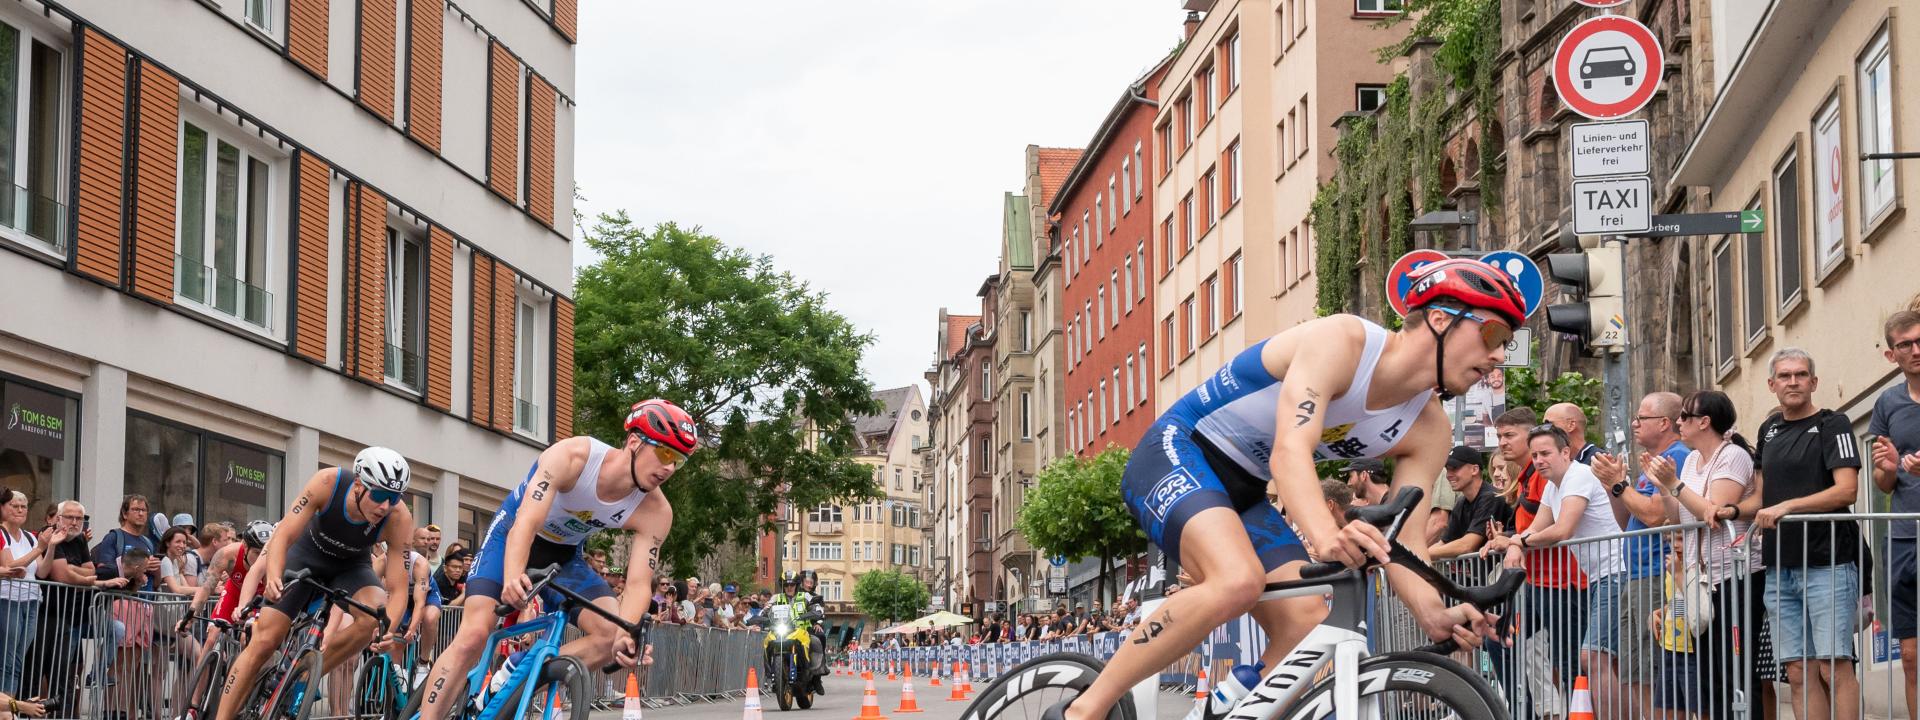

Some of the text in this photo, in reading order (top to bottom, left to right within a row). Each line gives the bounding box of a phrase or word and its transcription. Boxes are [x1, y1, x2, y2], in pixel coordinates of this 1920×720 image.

[1582, 131, 1637, 143] Linien- und
[1577, 143, 1644, 155] Lieferverkehr
[1602, 156, 1619, 166] frei
[1583, 188, 1639, 211] TAXI
[1600, 214, 1624, 227] frei
[1417, 278, 1431, 293] 47
[1605, 331, 1619, 340] 22
[22, 409, 63, 431] TOM & SEM
[1295, 400, 1316, 426] 47
[681, 422, 693, 433] 48
[235, 465, 248, 478] TOM
[253, 470, 265, 482] SEM
[389, 479, 401, 490] 36
[532, 481, 550, 501] 48
[1158, 483, 1195, 516] Bank
[402, 550, 410, 570] 36
[1133, 621, 1164, 645] 47
[1397, 667, 1435, 679] ZIPP
[427, 677, 446, 704] 48
[1230, 650, 1325, 720] YON
